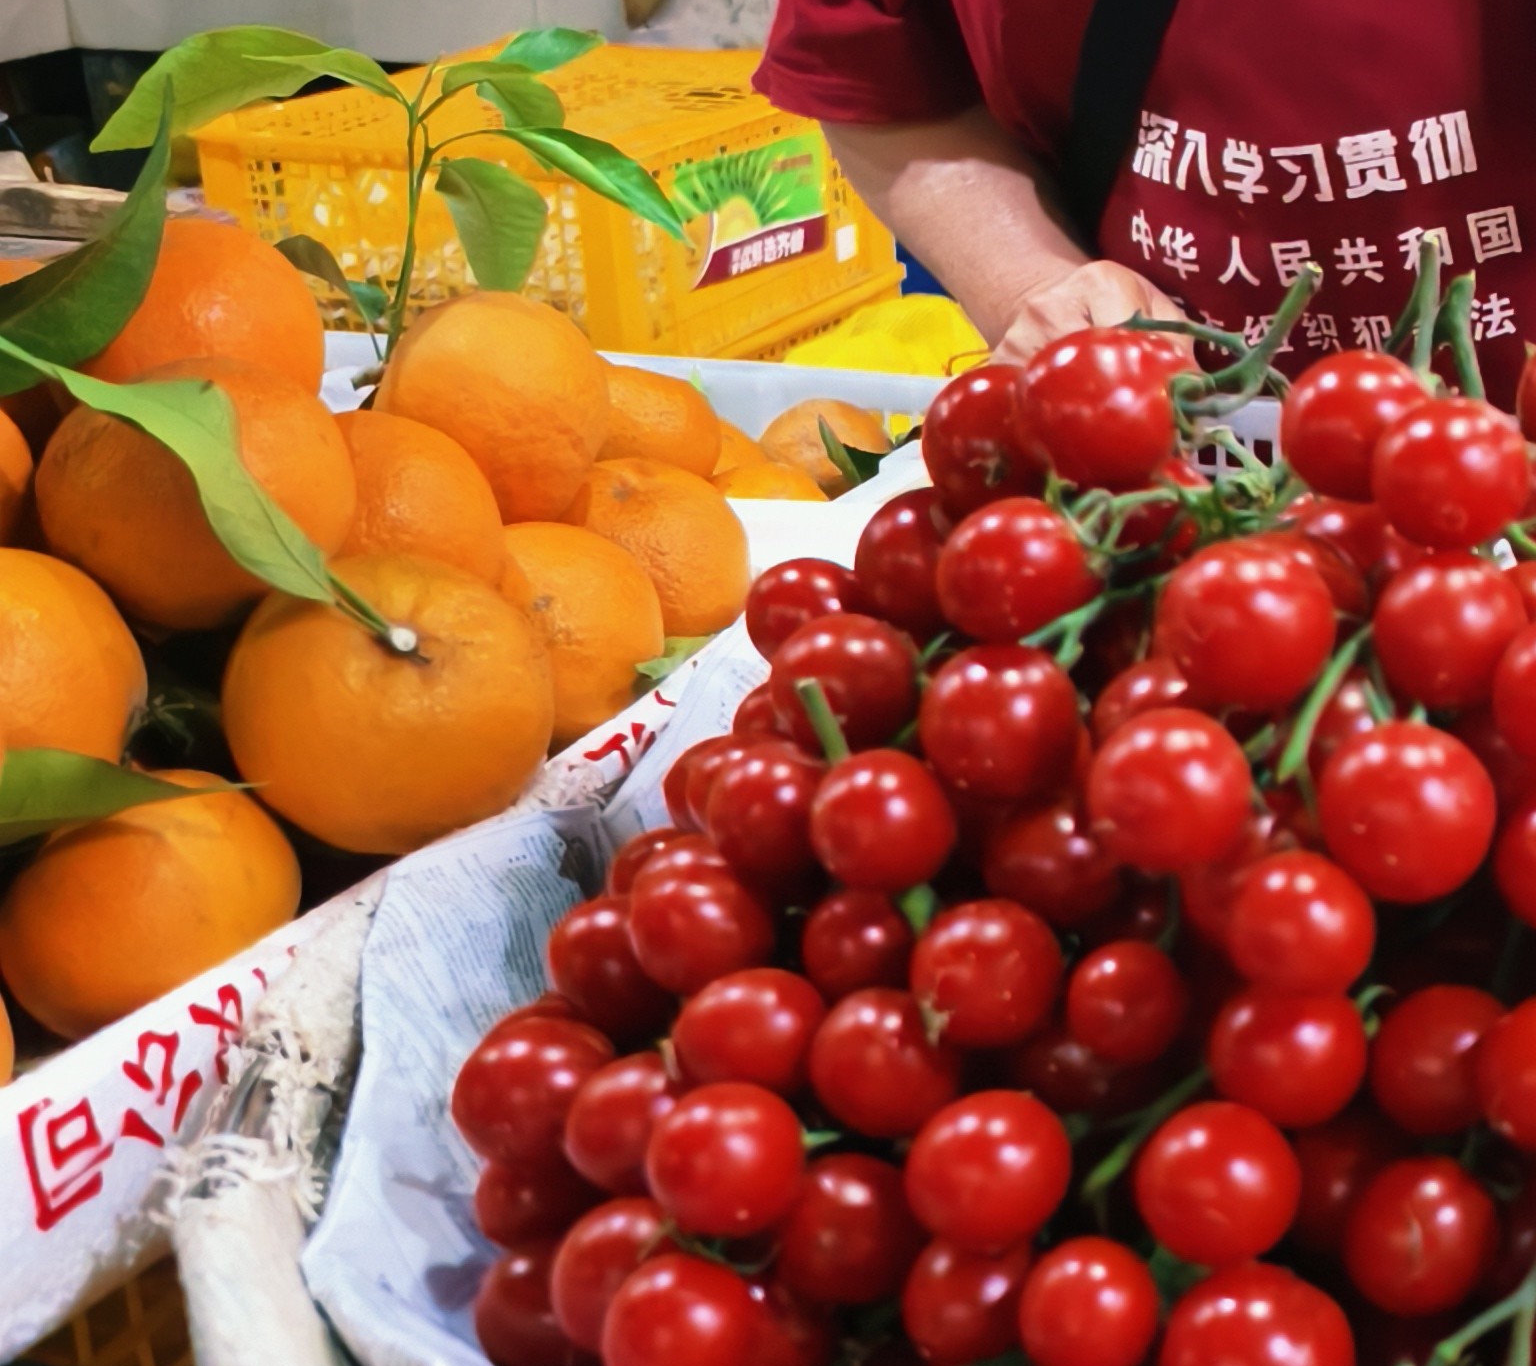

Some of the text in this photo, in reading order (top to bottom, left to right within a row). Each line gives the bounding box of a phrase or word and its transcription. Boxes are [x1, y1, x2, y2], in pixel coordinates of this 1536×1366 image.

[1132, 110, 1478, 204] 深入学习贯彻
[1130, 205, 1523, 289] 中华人民共和国
